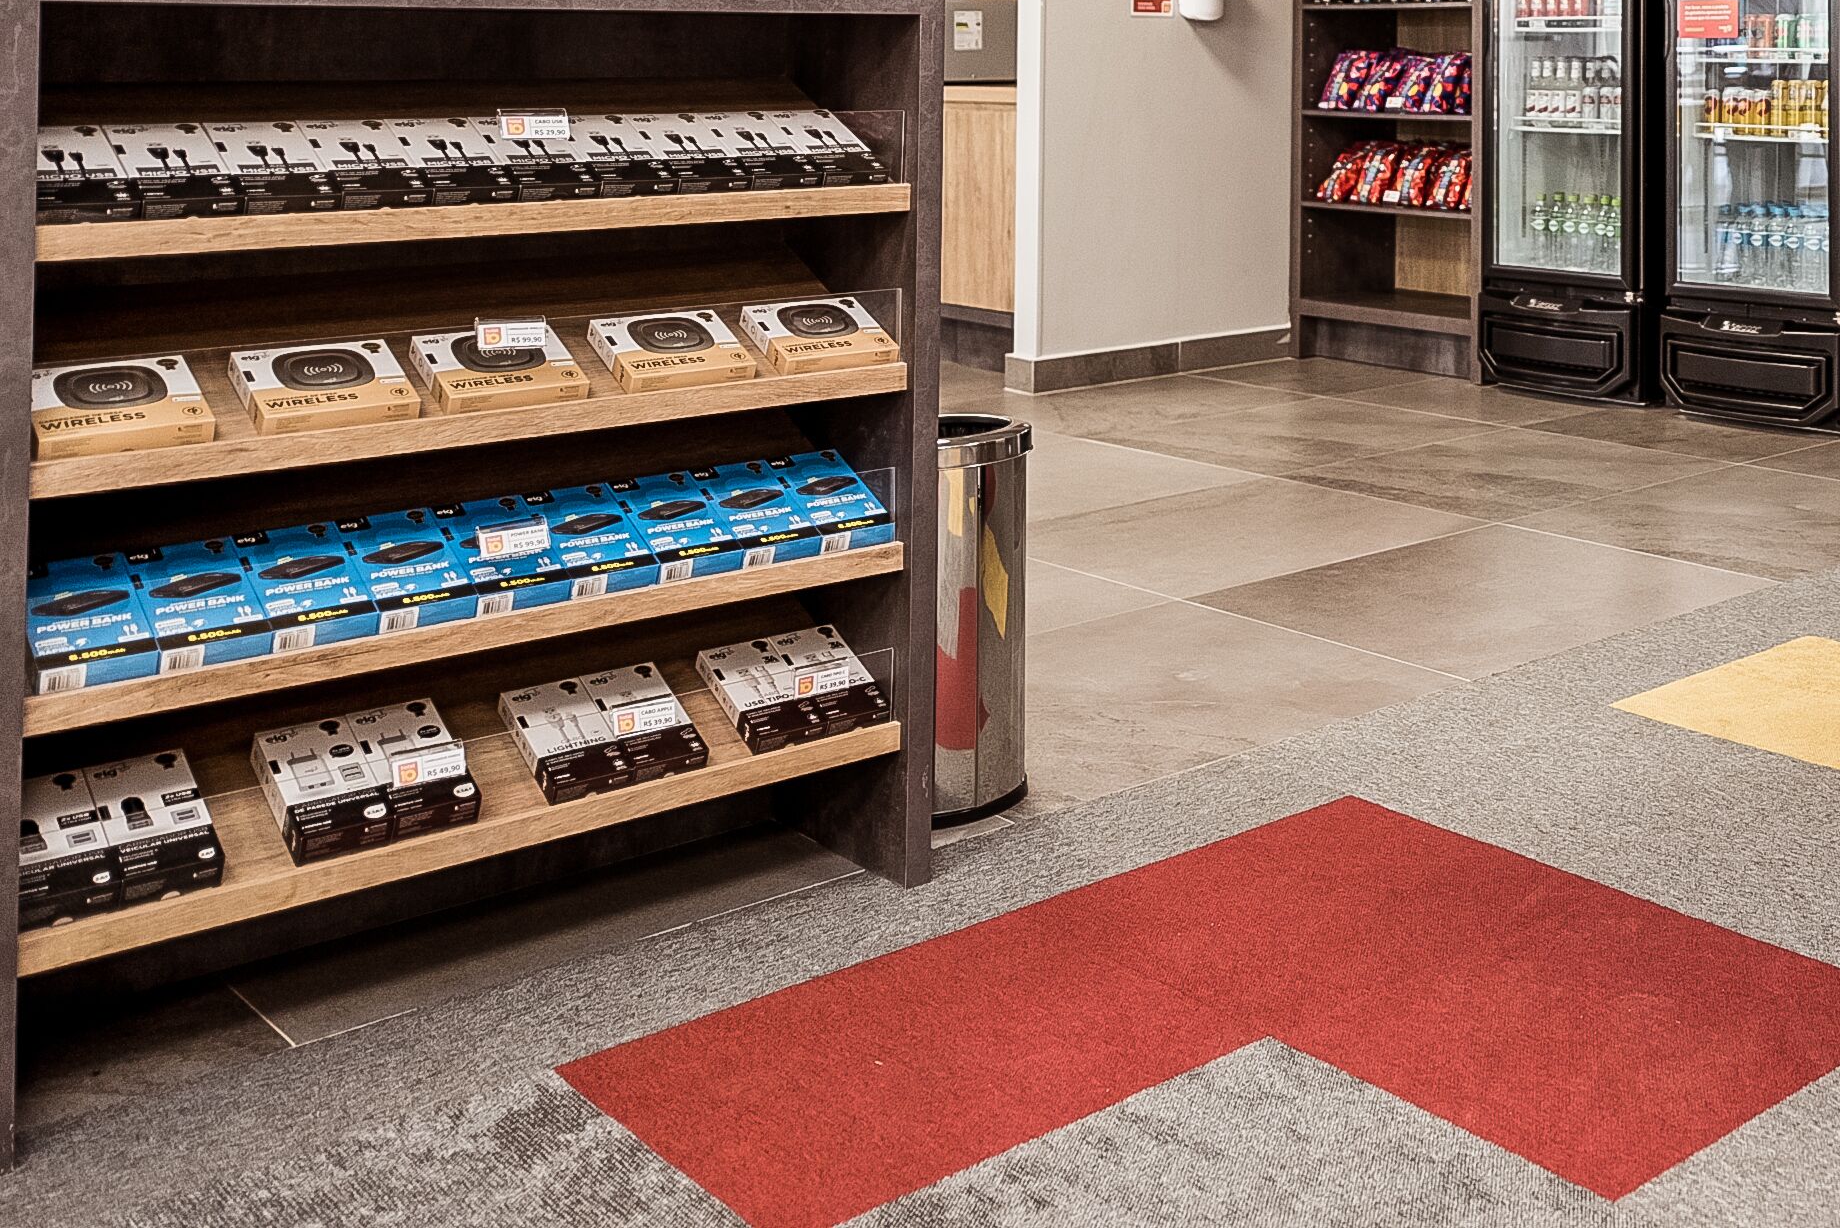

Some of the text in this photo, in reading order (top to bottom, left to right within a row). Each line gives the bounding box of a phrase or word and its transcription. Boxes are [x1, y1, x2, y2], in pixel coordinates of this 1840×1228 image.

[545, 129, 566, 137] 29,90
[521, 336, 542, 344] 99,90
[784, 339, 853, 354] WIRELESS
[630, 356, 706, 371] WIRELESS
[449, 374, 534, 390] WIRELESS
[266, 392, 359, 409] WIRELESS
[40, 411, 147, 432] WIRELESS
[525, 538, 545, 548] 99,90
[559, 532, 630, 549] POWER BANK
[370, 561, 449, 580] POWER BANK
[265, 576, 350, 597] POWER BANK
[155, 594, 245, 616] POWER BANK
[37, 613, 132, 634] POWER BANK
[828, 679, 846, 689] 39,90
[744, 693, 795, 708] USB TIPO-
[654, 716, 673, 726] 39,90
[547, 736, 607, 754] LIGHTNING
[439, 765, 461, 775] 49,90
[163, 830, 210, 844] UNIVERSAL
